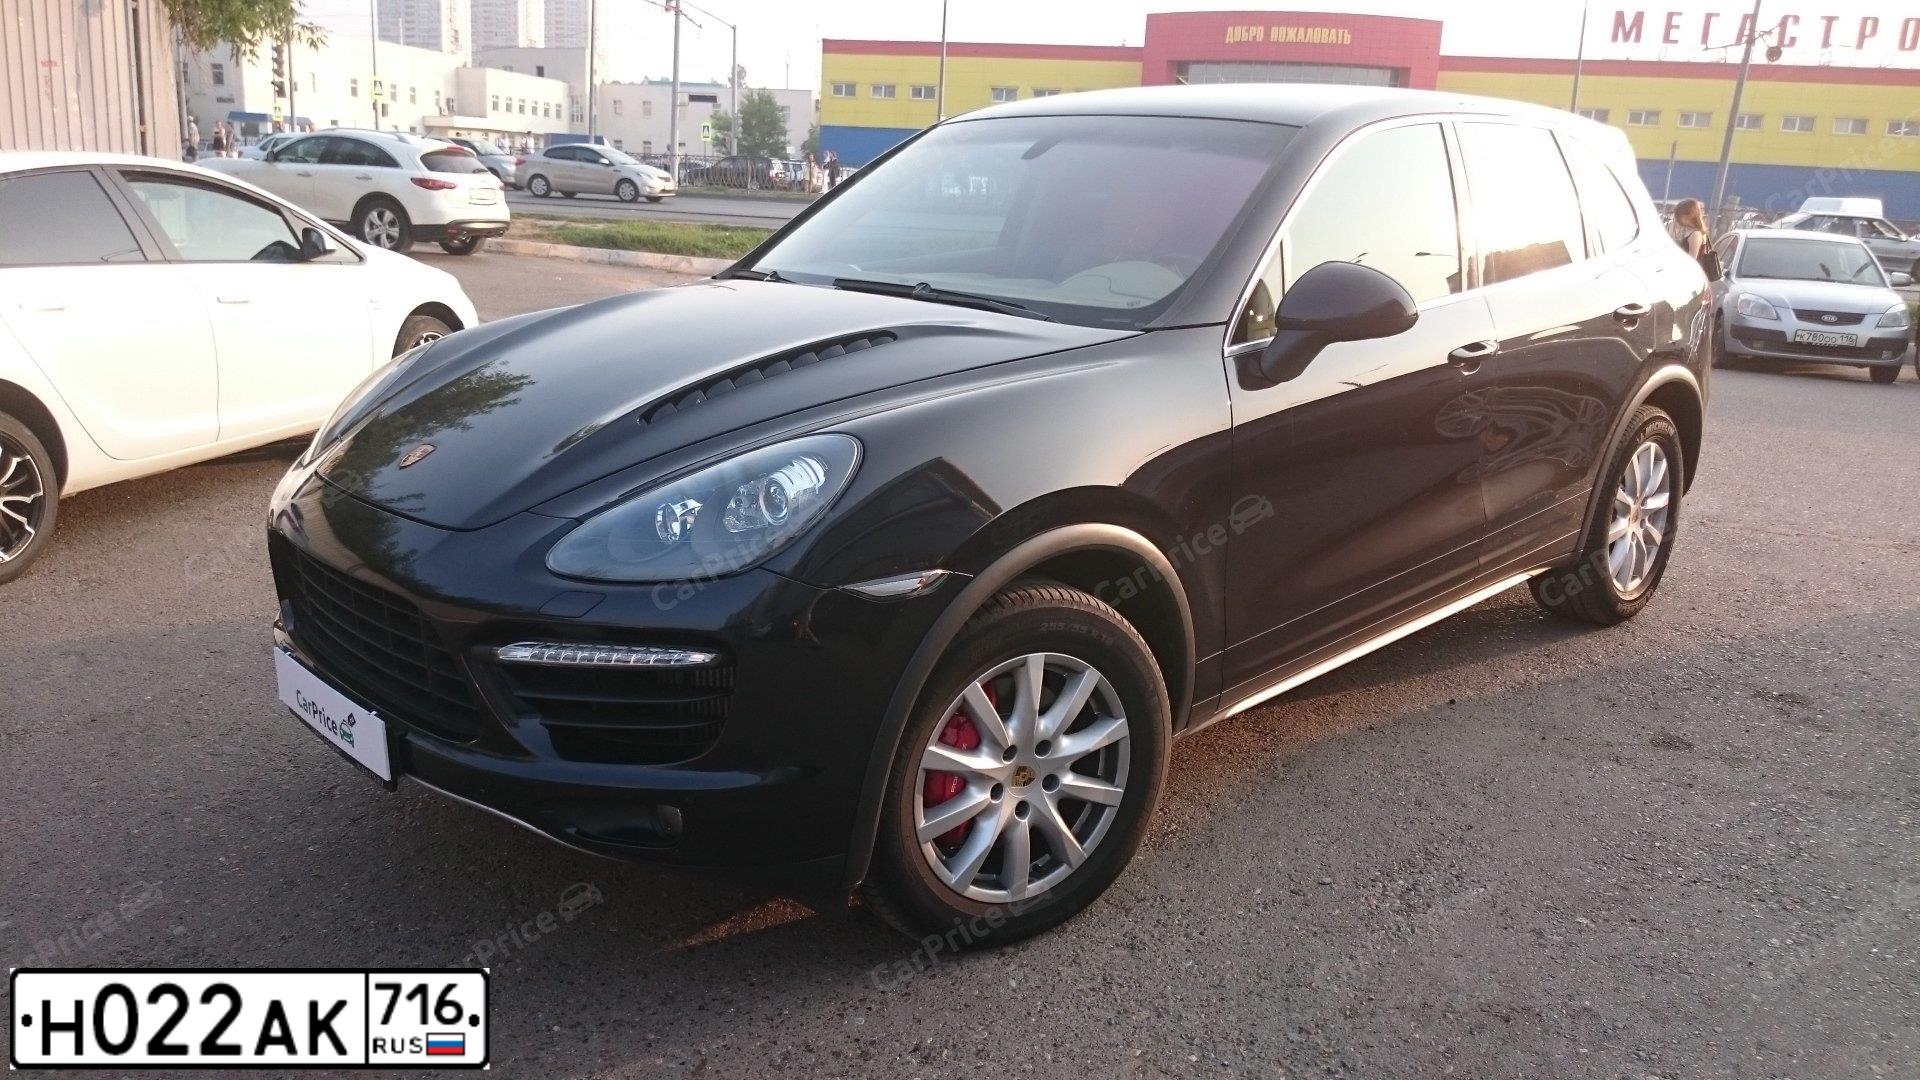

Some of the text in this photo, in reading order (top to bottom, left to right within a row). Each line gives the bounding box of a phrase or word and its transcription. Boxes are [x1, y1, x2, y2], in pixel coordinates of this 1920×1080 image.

[1225, 26, 1351, 44] ДОБРО ПОЖАЛОВАТЬ
[296, 689, 338, 735] CarPrice
